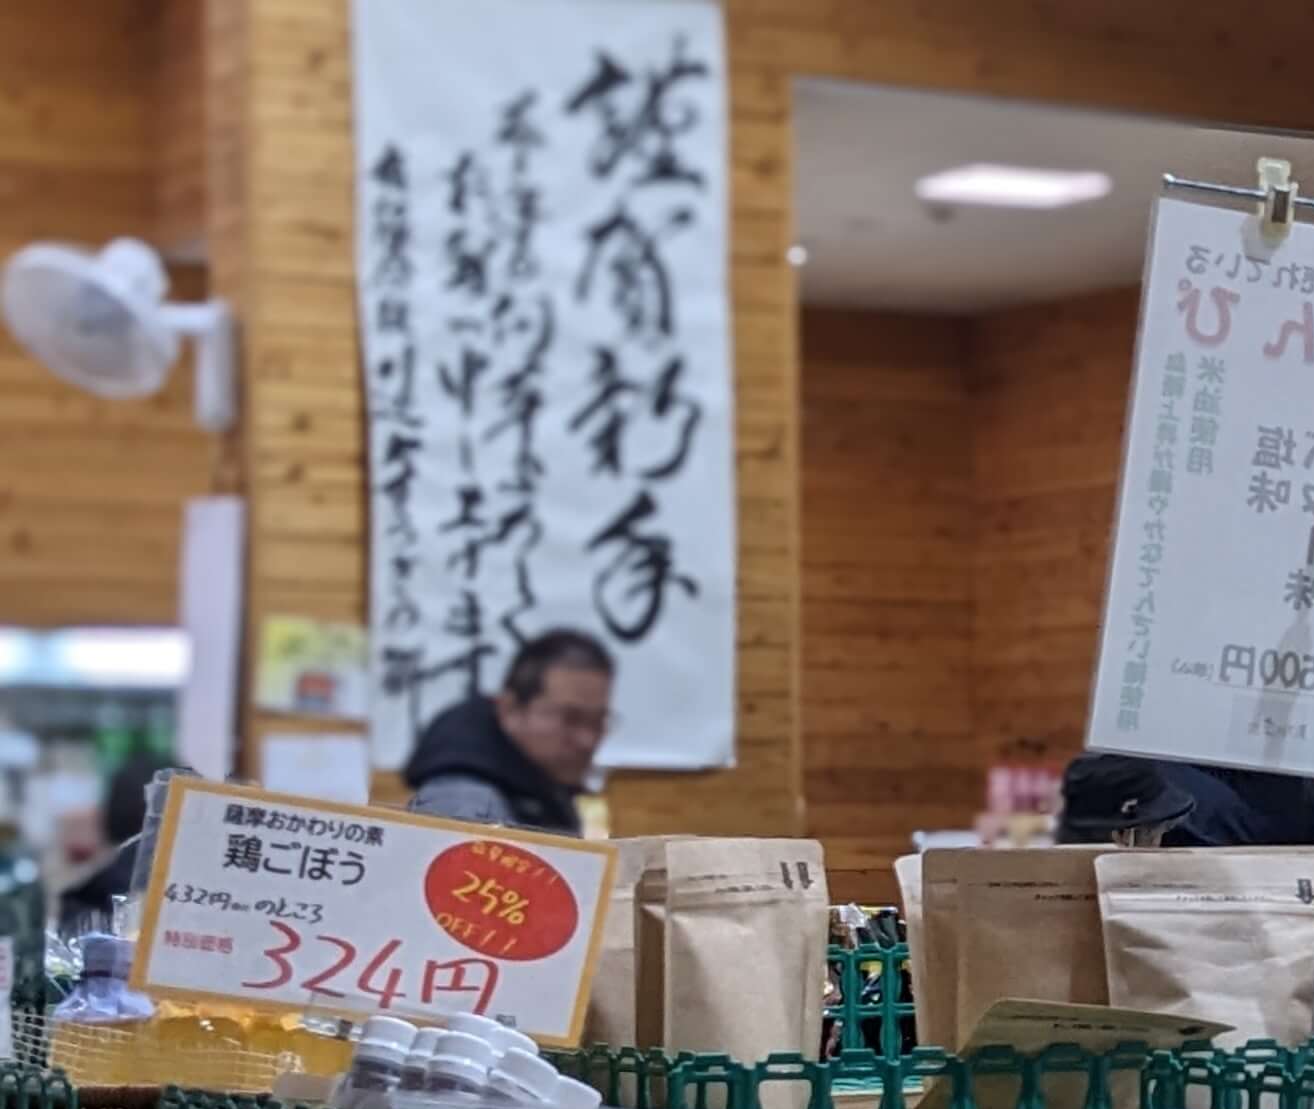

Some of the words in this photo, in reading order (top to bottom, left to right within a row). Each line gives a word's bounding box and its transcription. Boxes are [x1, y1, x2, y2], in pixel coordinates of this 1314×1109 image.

[222, 833, 366, 886] 鶏ごぼう
[452, 869, 530, 926] 25%
[240, 919, 500, 1018] 324円
